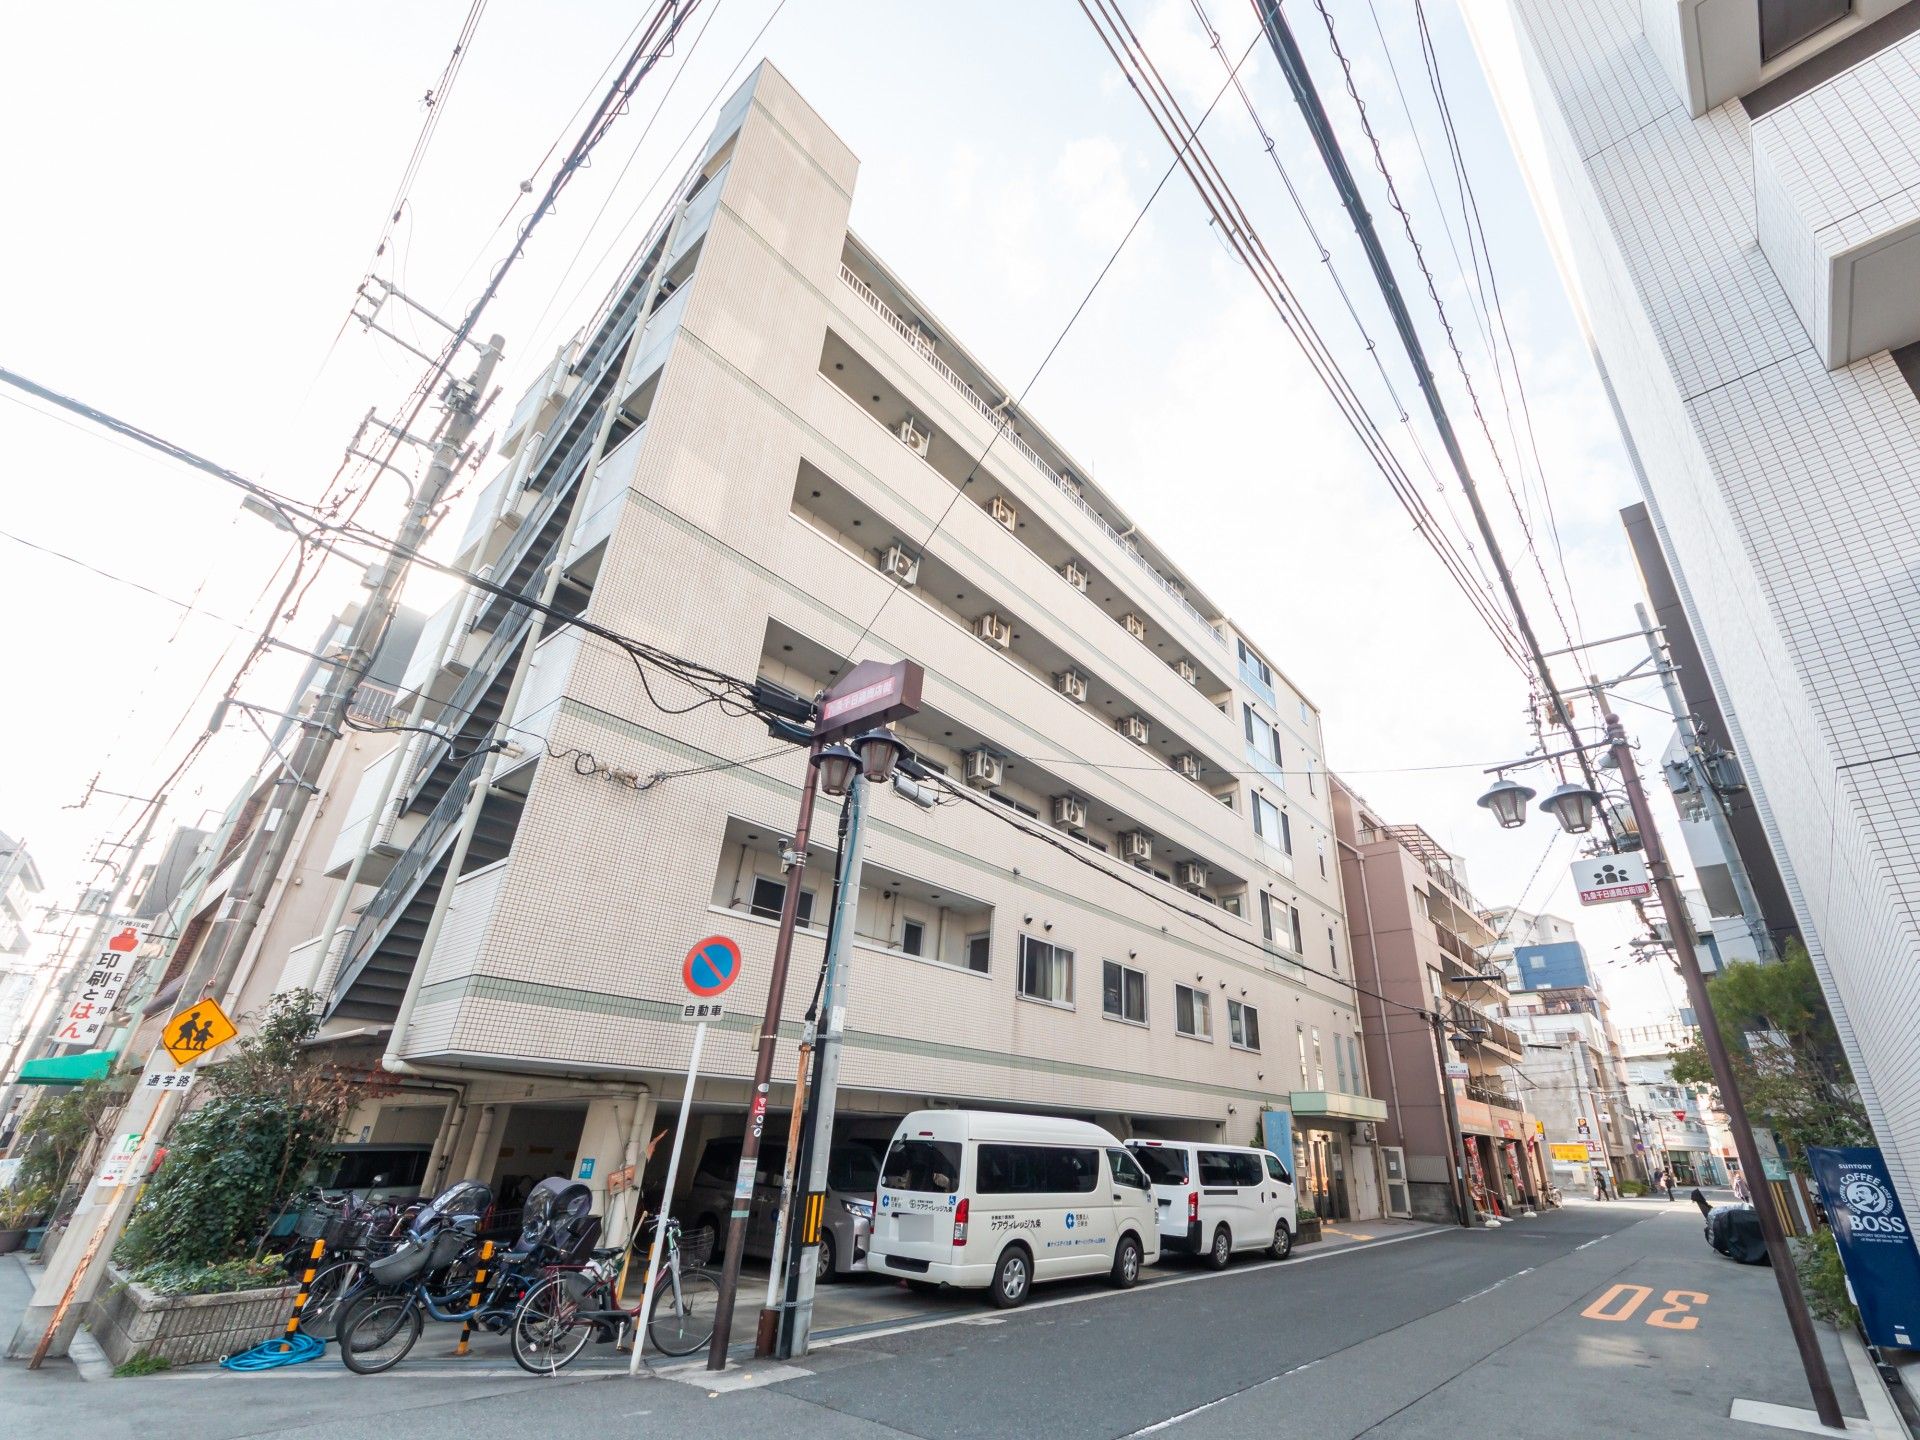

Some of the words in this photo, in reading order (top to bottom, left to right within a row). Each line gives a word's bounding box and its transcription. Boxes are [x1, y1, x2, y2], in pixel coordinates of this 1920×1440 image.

[59, 952, 121, 1039] 印刷とはん
[87, 972, 125, 1033] 石田印刷
[684, 1004, 722, 1017] 自動車
[146, 1074, 191, 1087] 通学路
[1840, 1172, 1881, 1186] COFFEE
[991, 1219, 1042, 1231] ケアヴィレッジ九条
[1848, 1215, 1905, 1233] BOSS
[1580, 1283, 1710, 1330] 30
